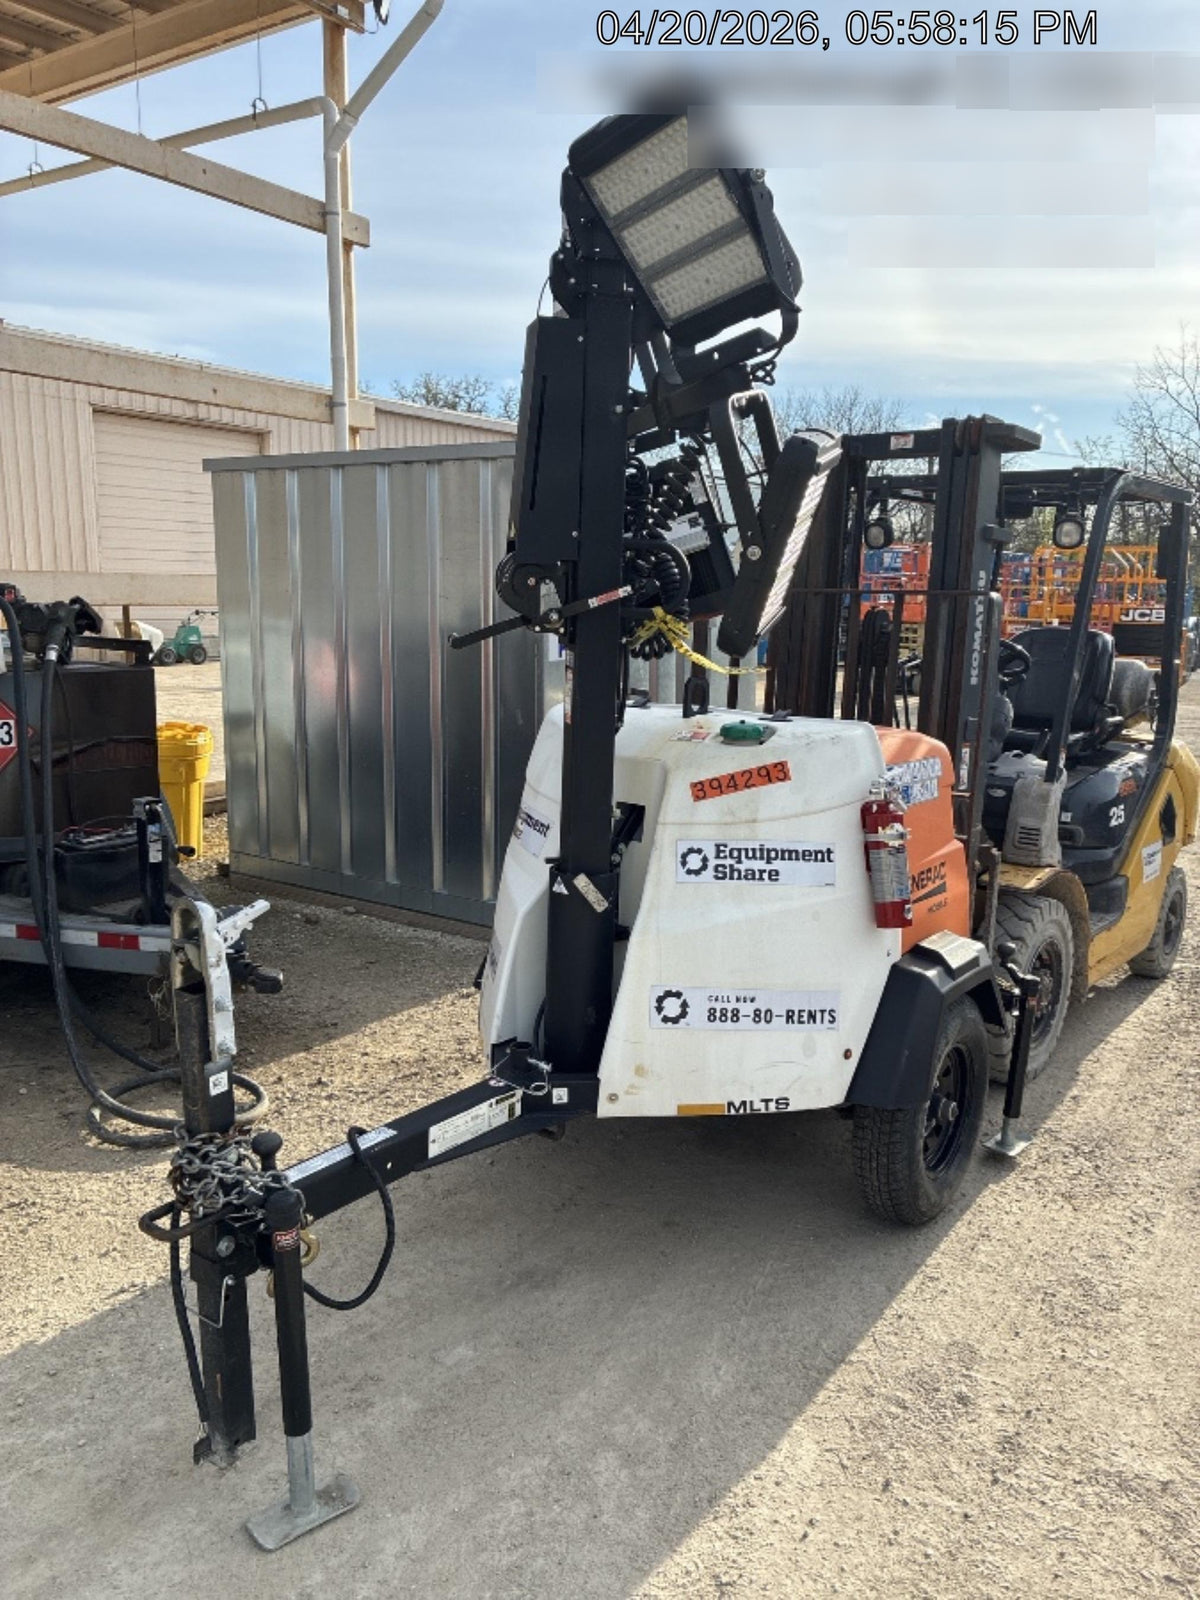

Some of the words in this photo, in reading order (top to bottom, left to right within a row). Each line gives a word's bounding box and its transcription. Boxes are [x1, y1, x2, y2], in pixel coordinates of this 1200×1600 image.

[1120, 609, 1166, 622] JCB
[692, 762, 788, 800] 394293
[1109, 804, 1125, 827] 25
[714, 843, 834, 865] Equipment
[713, 863, 780, 882] Share
[910, 860, 946, 893] NERAC
[707, 995, 731, 1003] CALL
[735, 996, 757, 1004] NOW
[707, 1007, 837, 1025] 888-80-RENTS
[727, 1097, 791, 1114] MLTS
